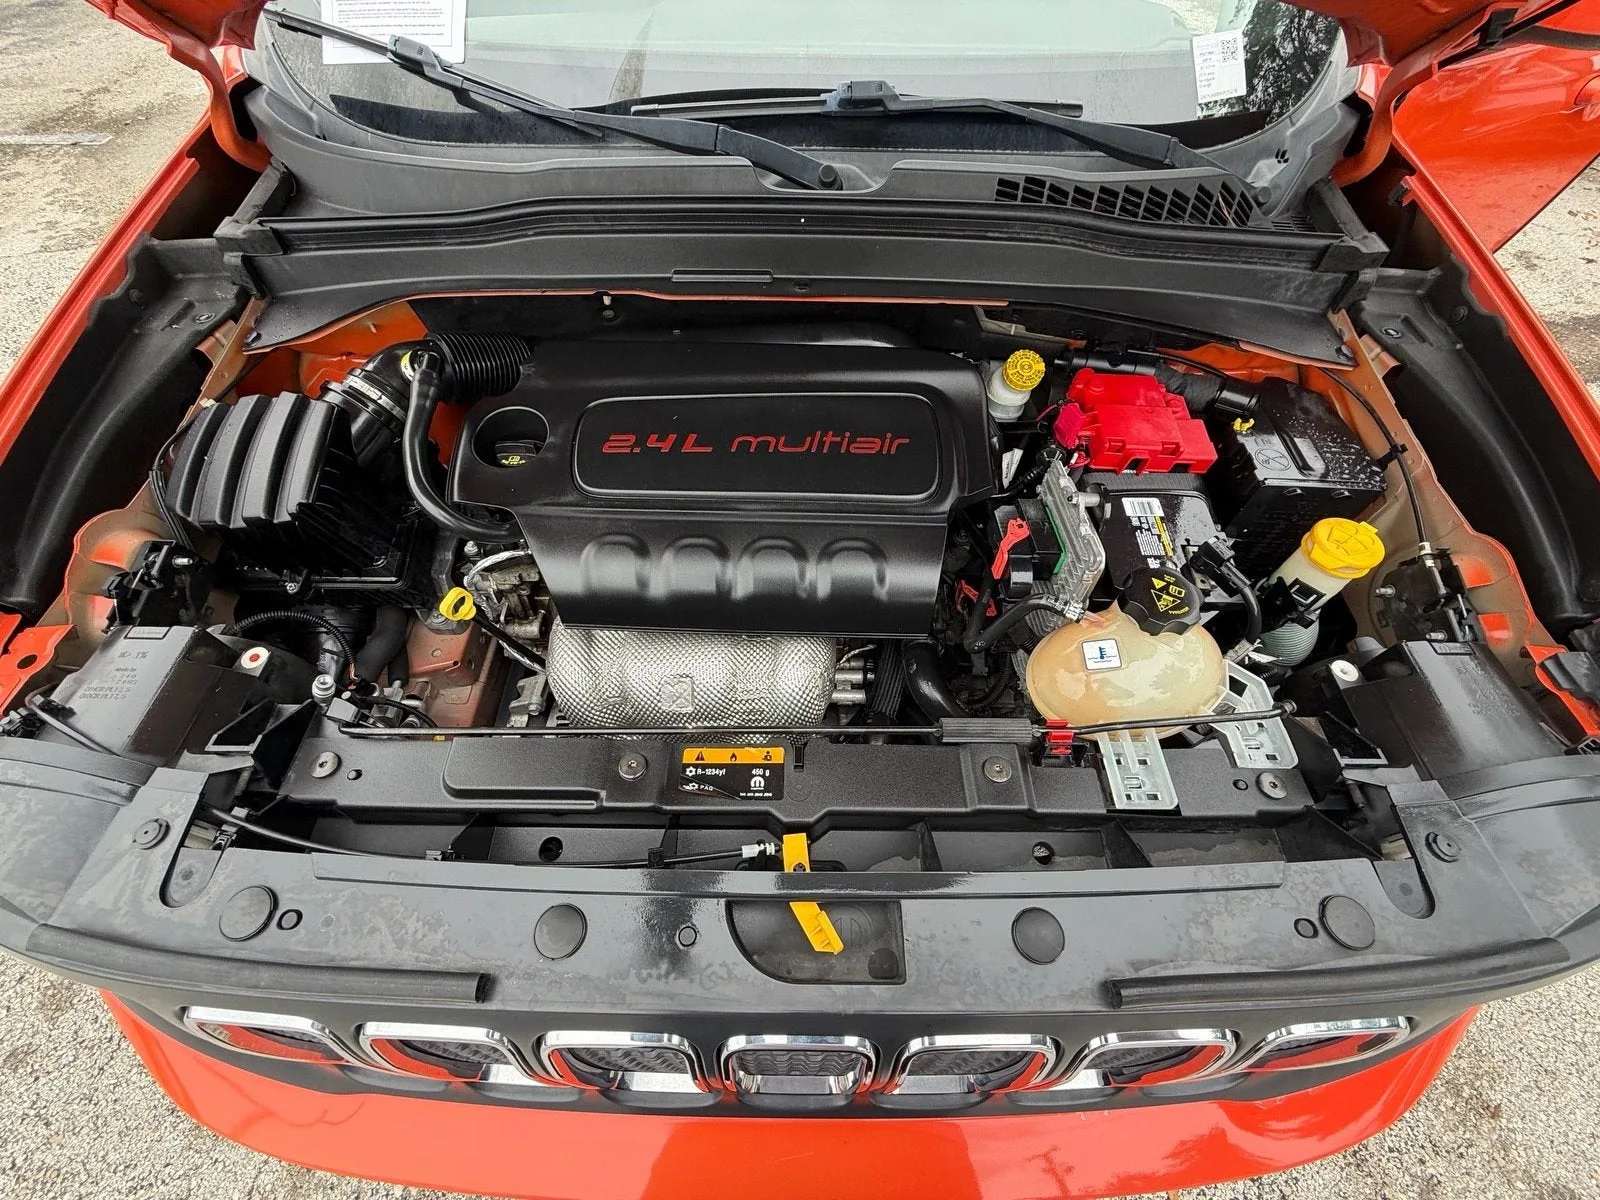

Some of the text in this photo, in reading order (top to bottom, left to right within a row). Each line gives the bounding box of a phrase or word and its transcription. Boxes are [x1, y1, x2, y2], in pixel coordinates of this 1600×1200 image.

[731, 431, 910, 454] multiair
[751, 768, 764, 776] 450
[765, 769, 770, 777] g
